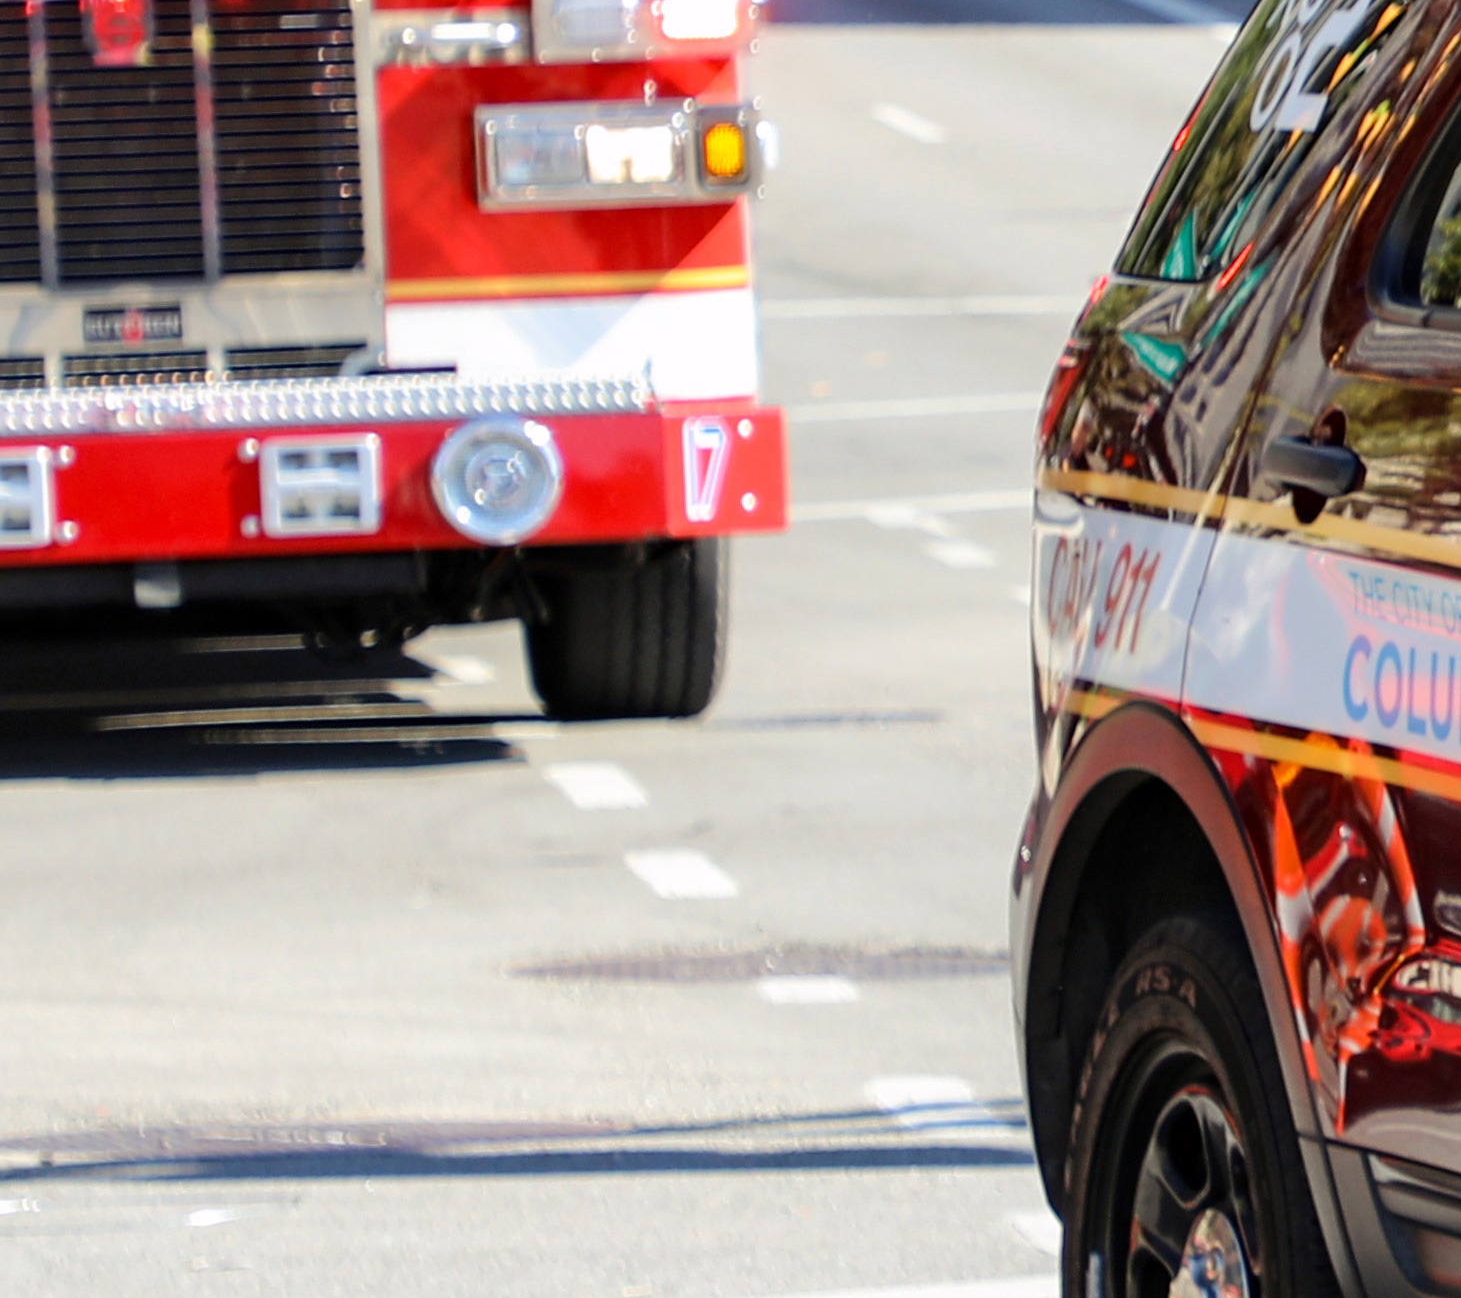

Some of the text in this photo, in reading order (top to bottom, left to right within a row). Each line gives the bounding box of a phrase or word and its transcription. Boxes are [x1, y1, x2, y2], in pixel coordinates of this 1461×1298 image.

[1095, 539, 1162, 653] 911
[1348, 571, 1387, 619] THE
[1392, 581, 1434, 627] CITY
